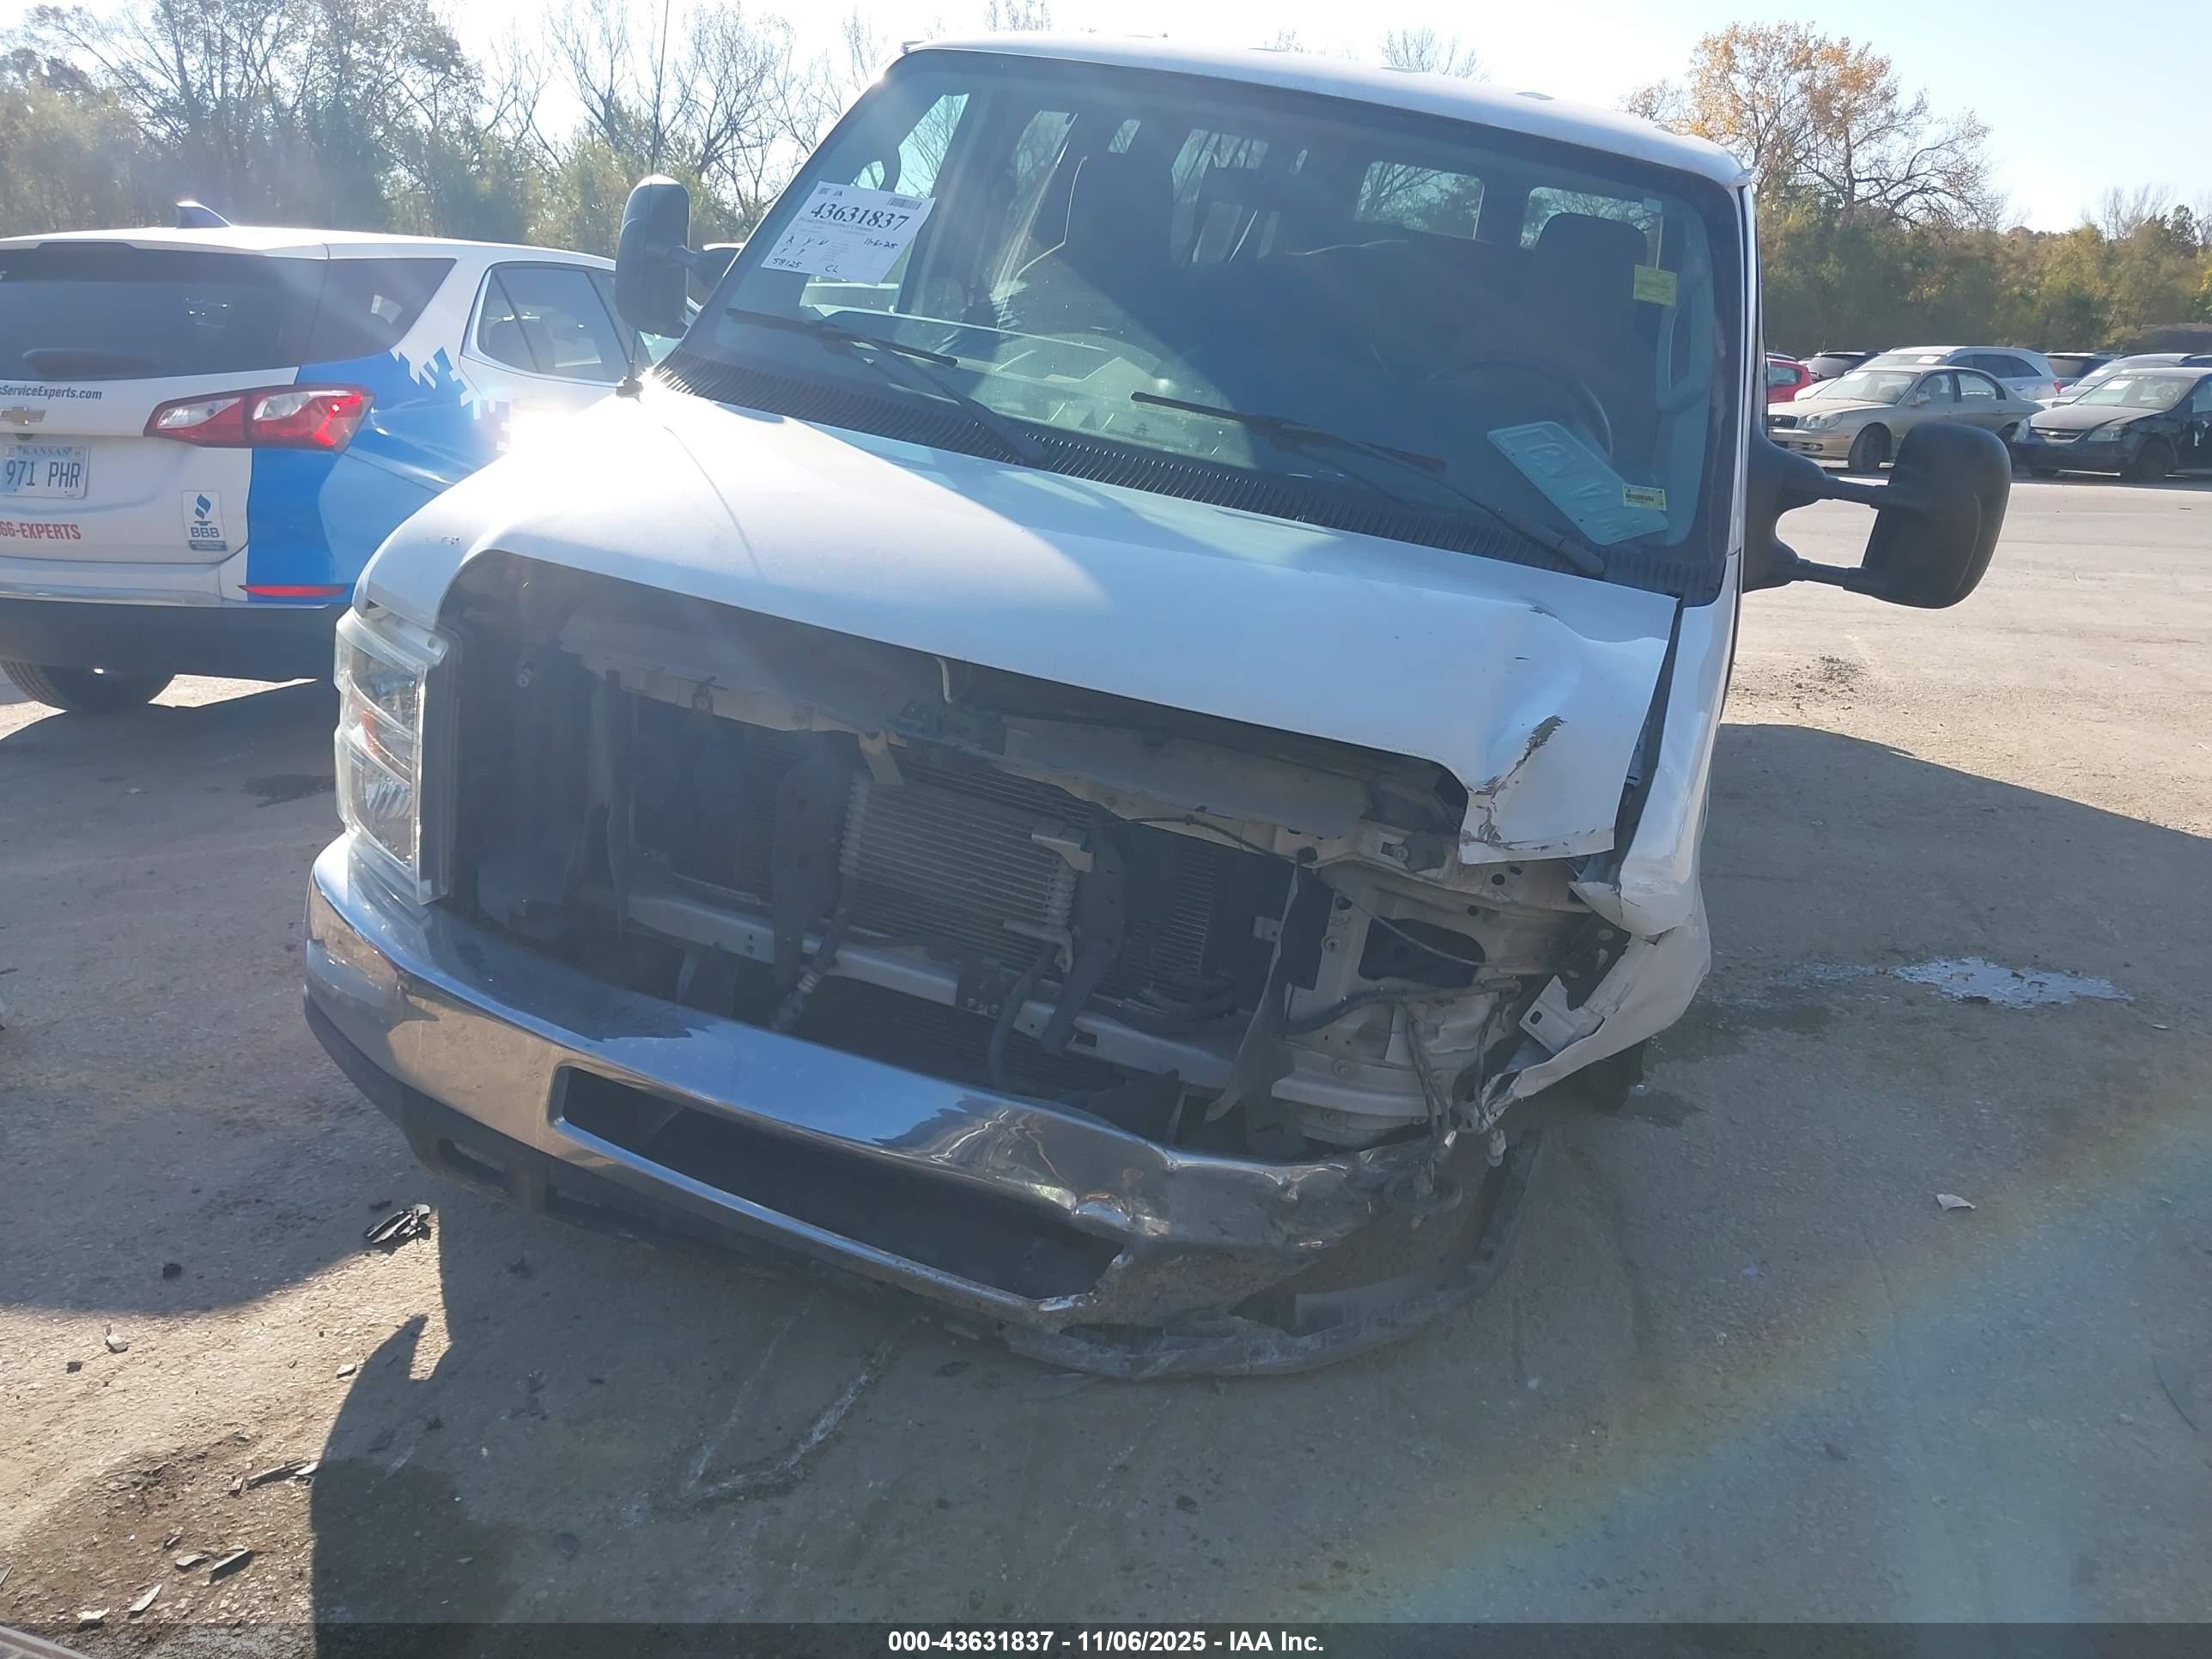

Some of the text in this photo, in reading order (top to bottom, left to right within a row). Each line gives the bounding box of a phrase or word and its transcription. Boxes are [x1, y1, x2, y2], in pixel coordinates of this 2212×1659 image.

[811, 202, 910, 232] 43631837
[6, 459, 81, 489] 971 PHR
[191, 526, 220, 538] BBB
